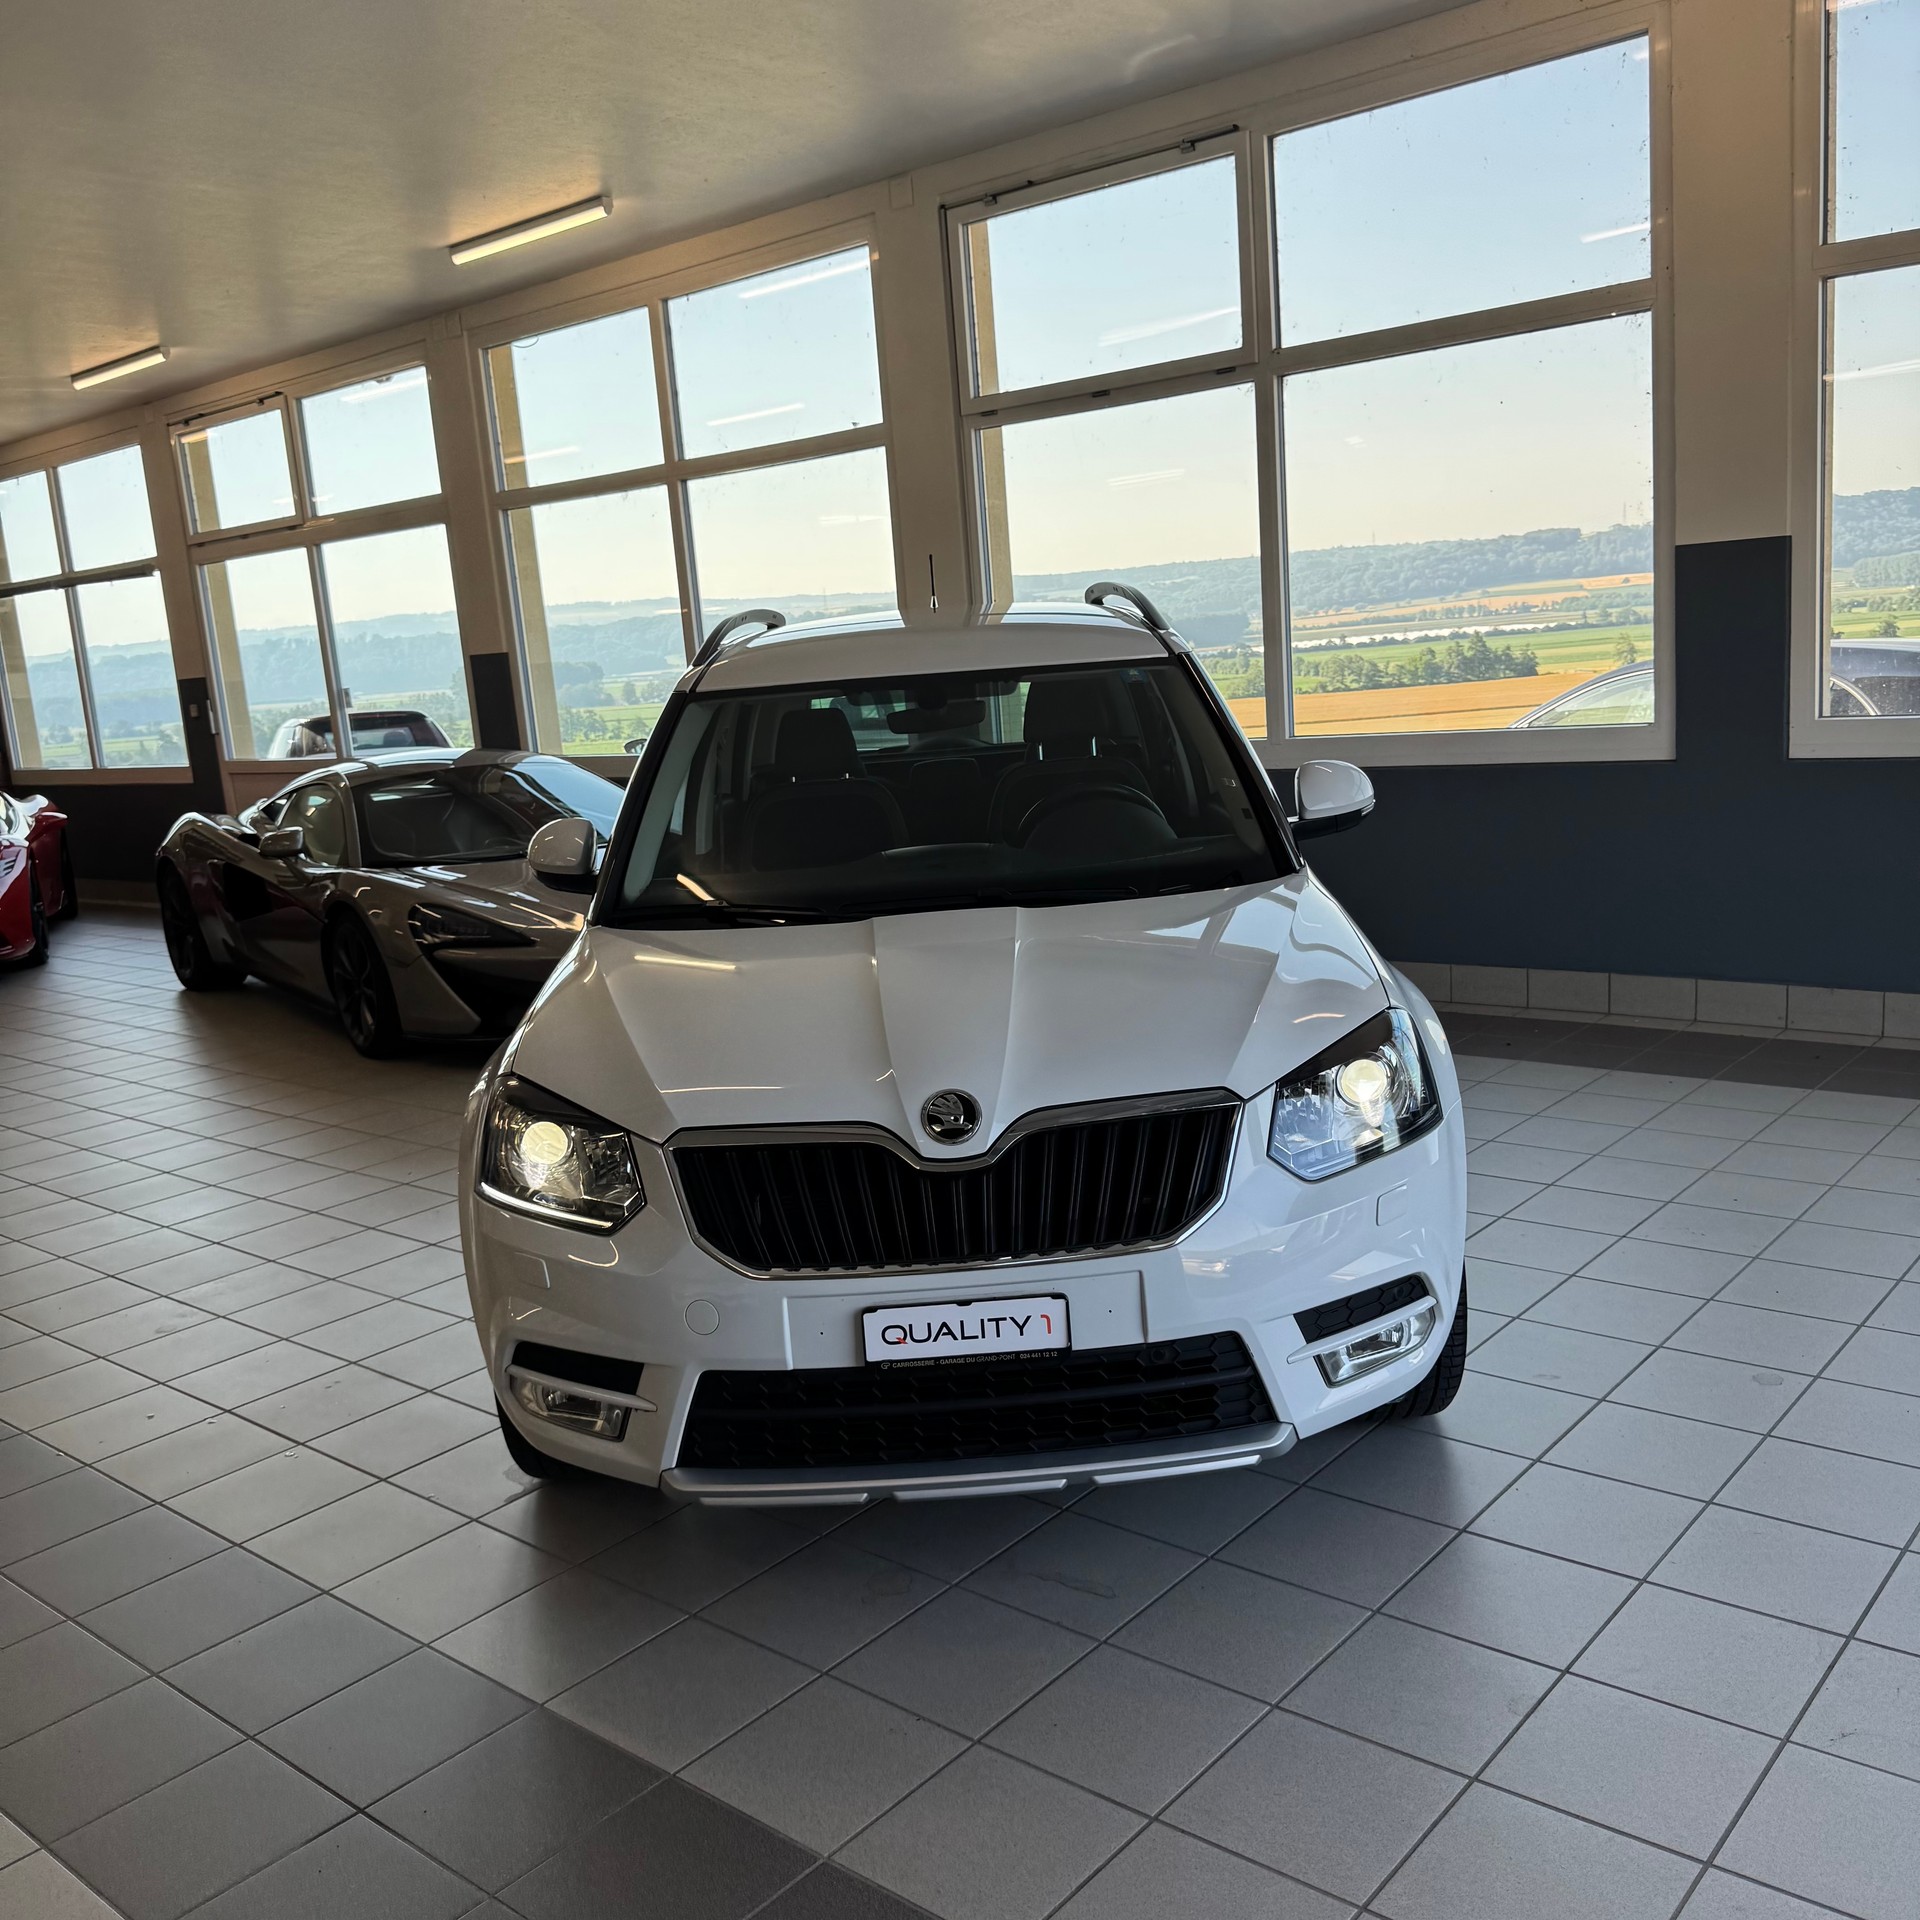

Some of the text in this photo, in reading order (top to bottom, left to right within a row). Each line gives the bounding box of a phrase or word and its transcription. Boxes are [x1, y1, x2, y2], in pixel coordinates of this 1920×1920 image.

[881, 1314, 1052, 1345] QUALITY 1
[892, 1359, 935, 1369] CARROSSERIE
[940, 1357, 966, 1365] GARAGE
[976, 1353, 1016, 1362] GRAND-PONT
